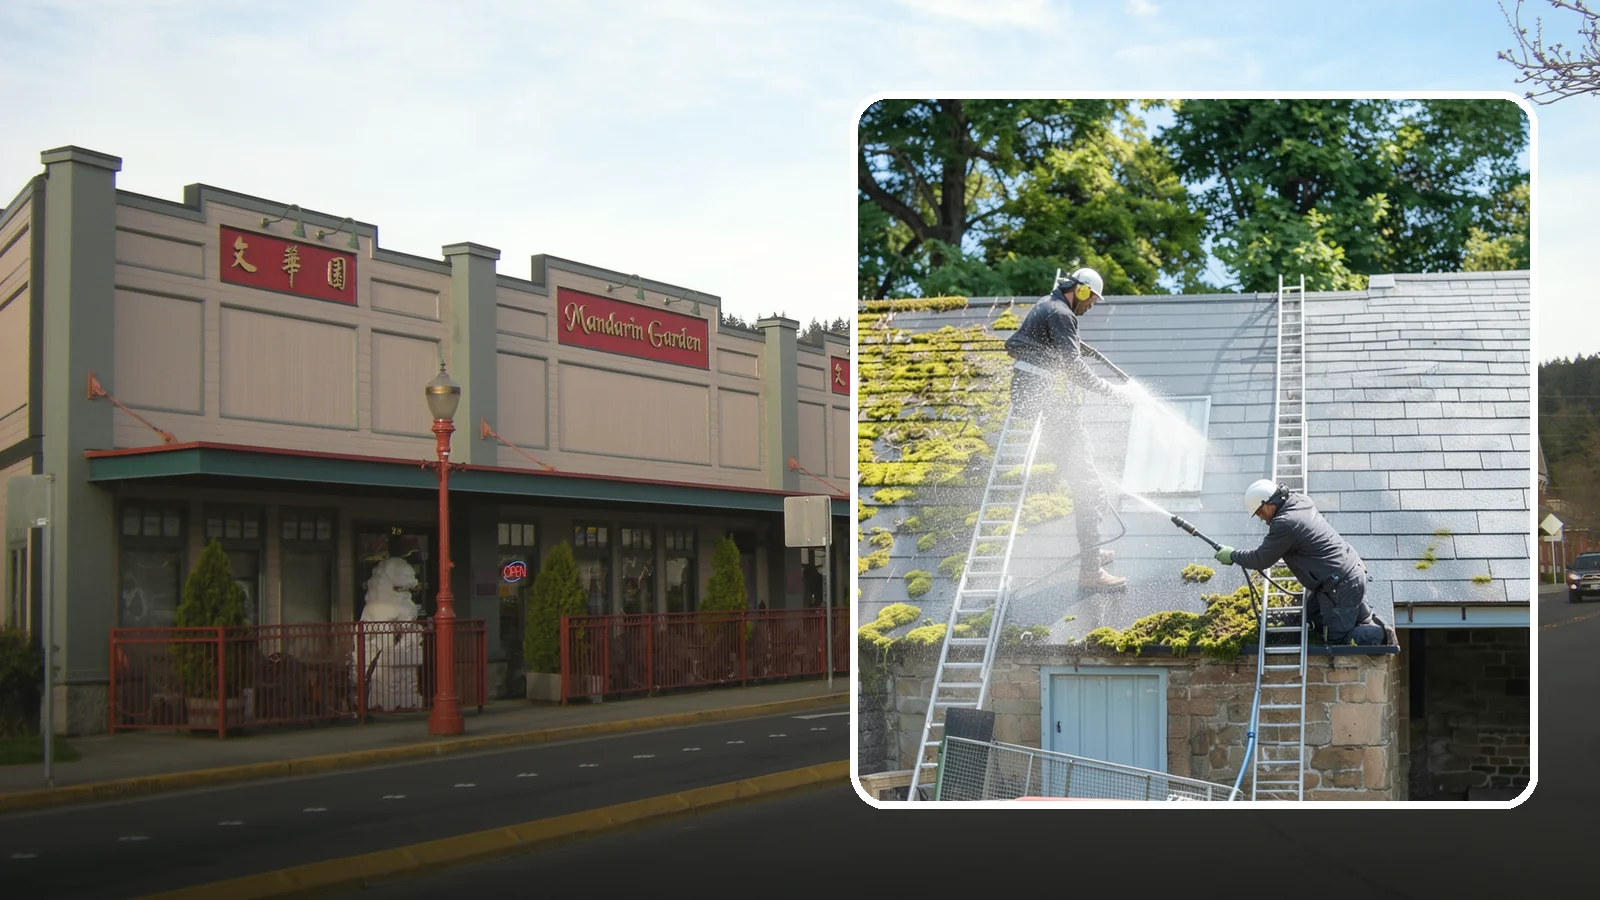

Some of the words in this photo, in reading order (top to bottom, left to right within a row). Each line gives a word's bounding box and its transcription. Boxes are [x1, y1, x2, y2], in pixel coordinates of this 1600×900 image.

[230, 235, 346, 291] 文華園
[564, 302, 644, 340] Mandarin
[647, 320, 701, 352] Garden
[503, 565, 527, 578] OPEN
